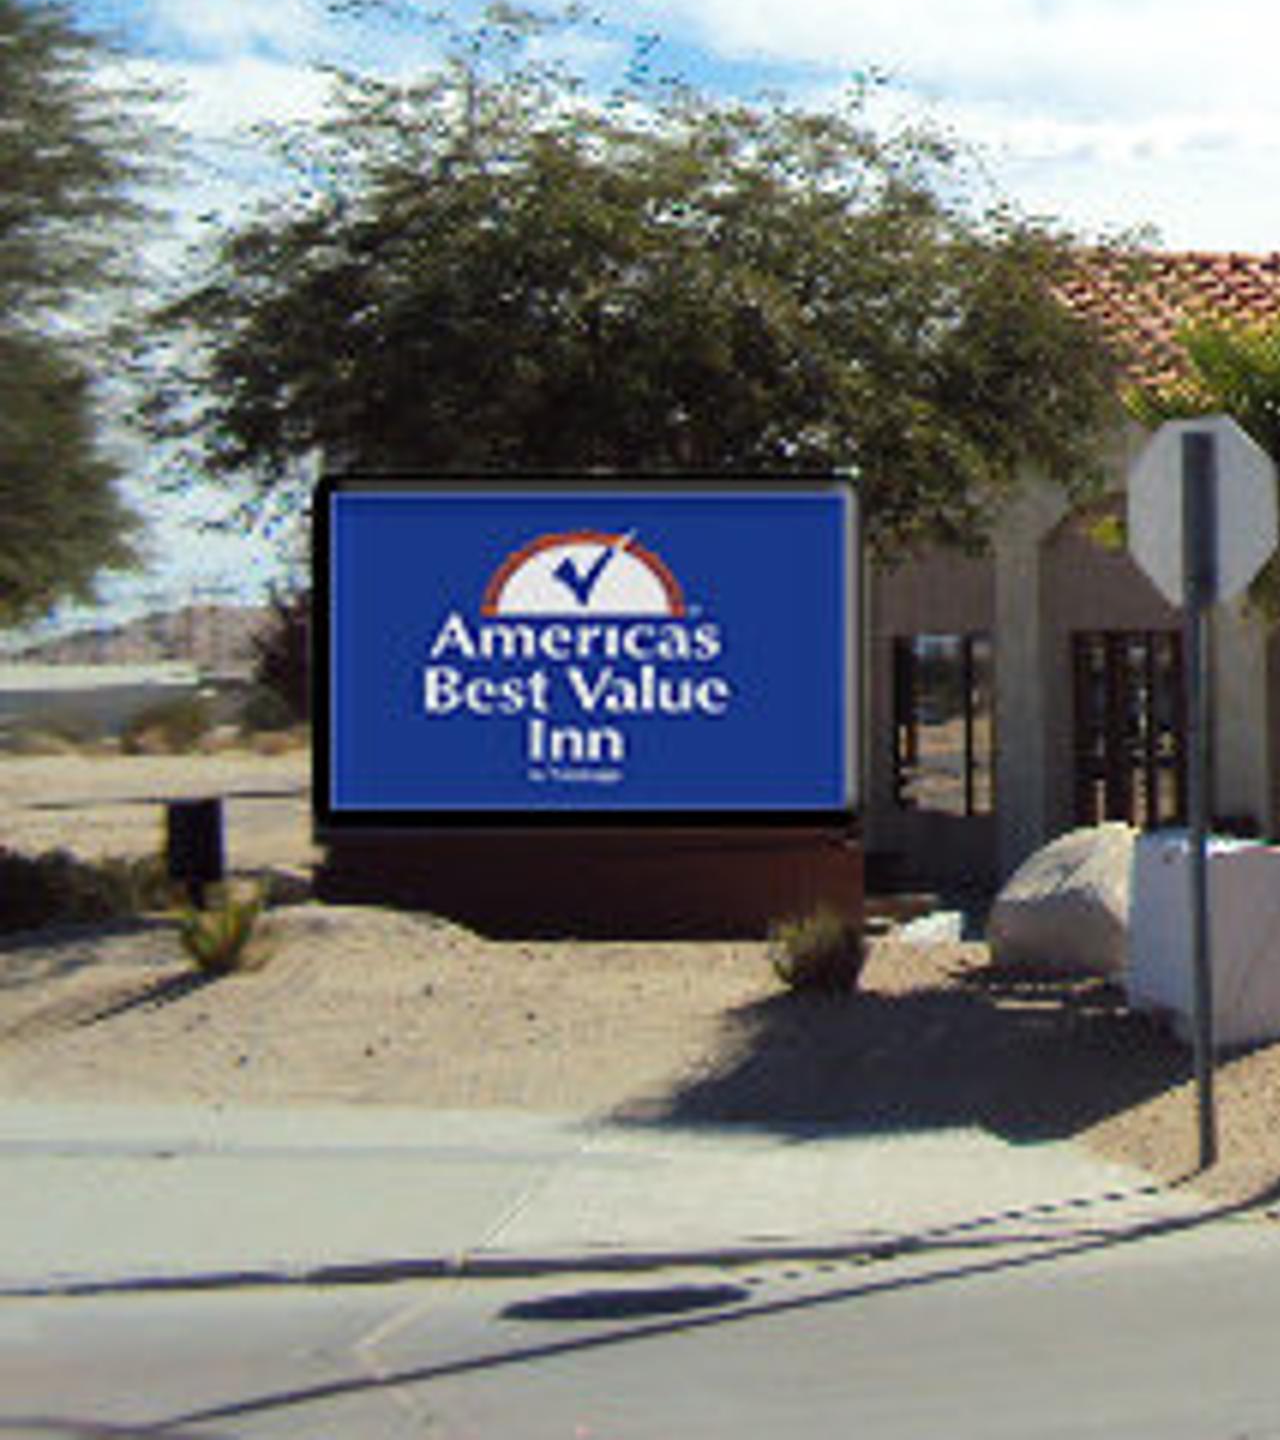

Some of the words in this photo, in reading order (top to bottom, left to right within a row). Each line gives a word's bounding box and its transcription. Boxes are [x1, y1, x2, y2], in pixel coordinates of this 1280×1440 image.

[430, 612, 721, 659] Americas
[423, 665, 550, 713] Best
[565, 665, 730, 713] Value
[528, 718, 625, 761] Inn
